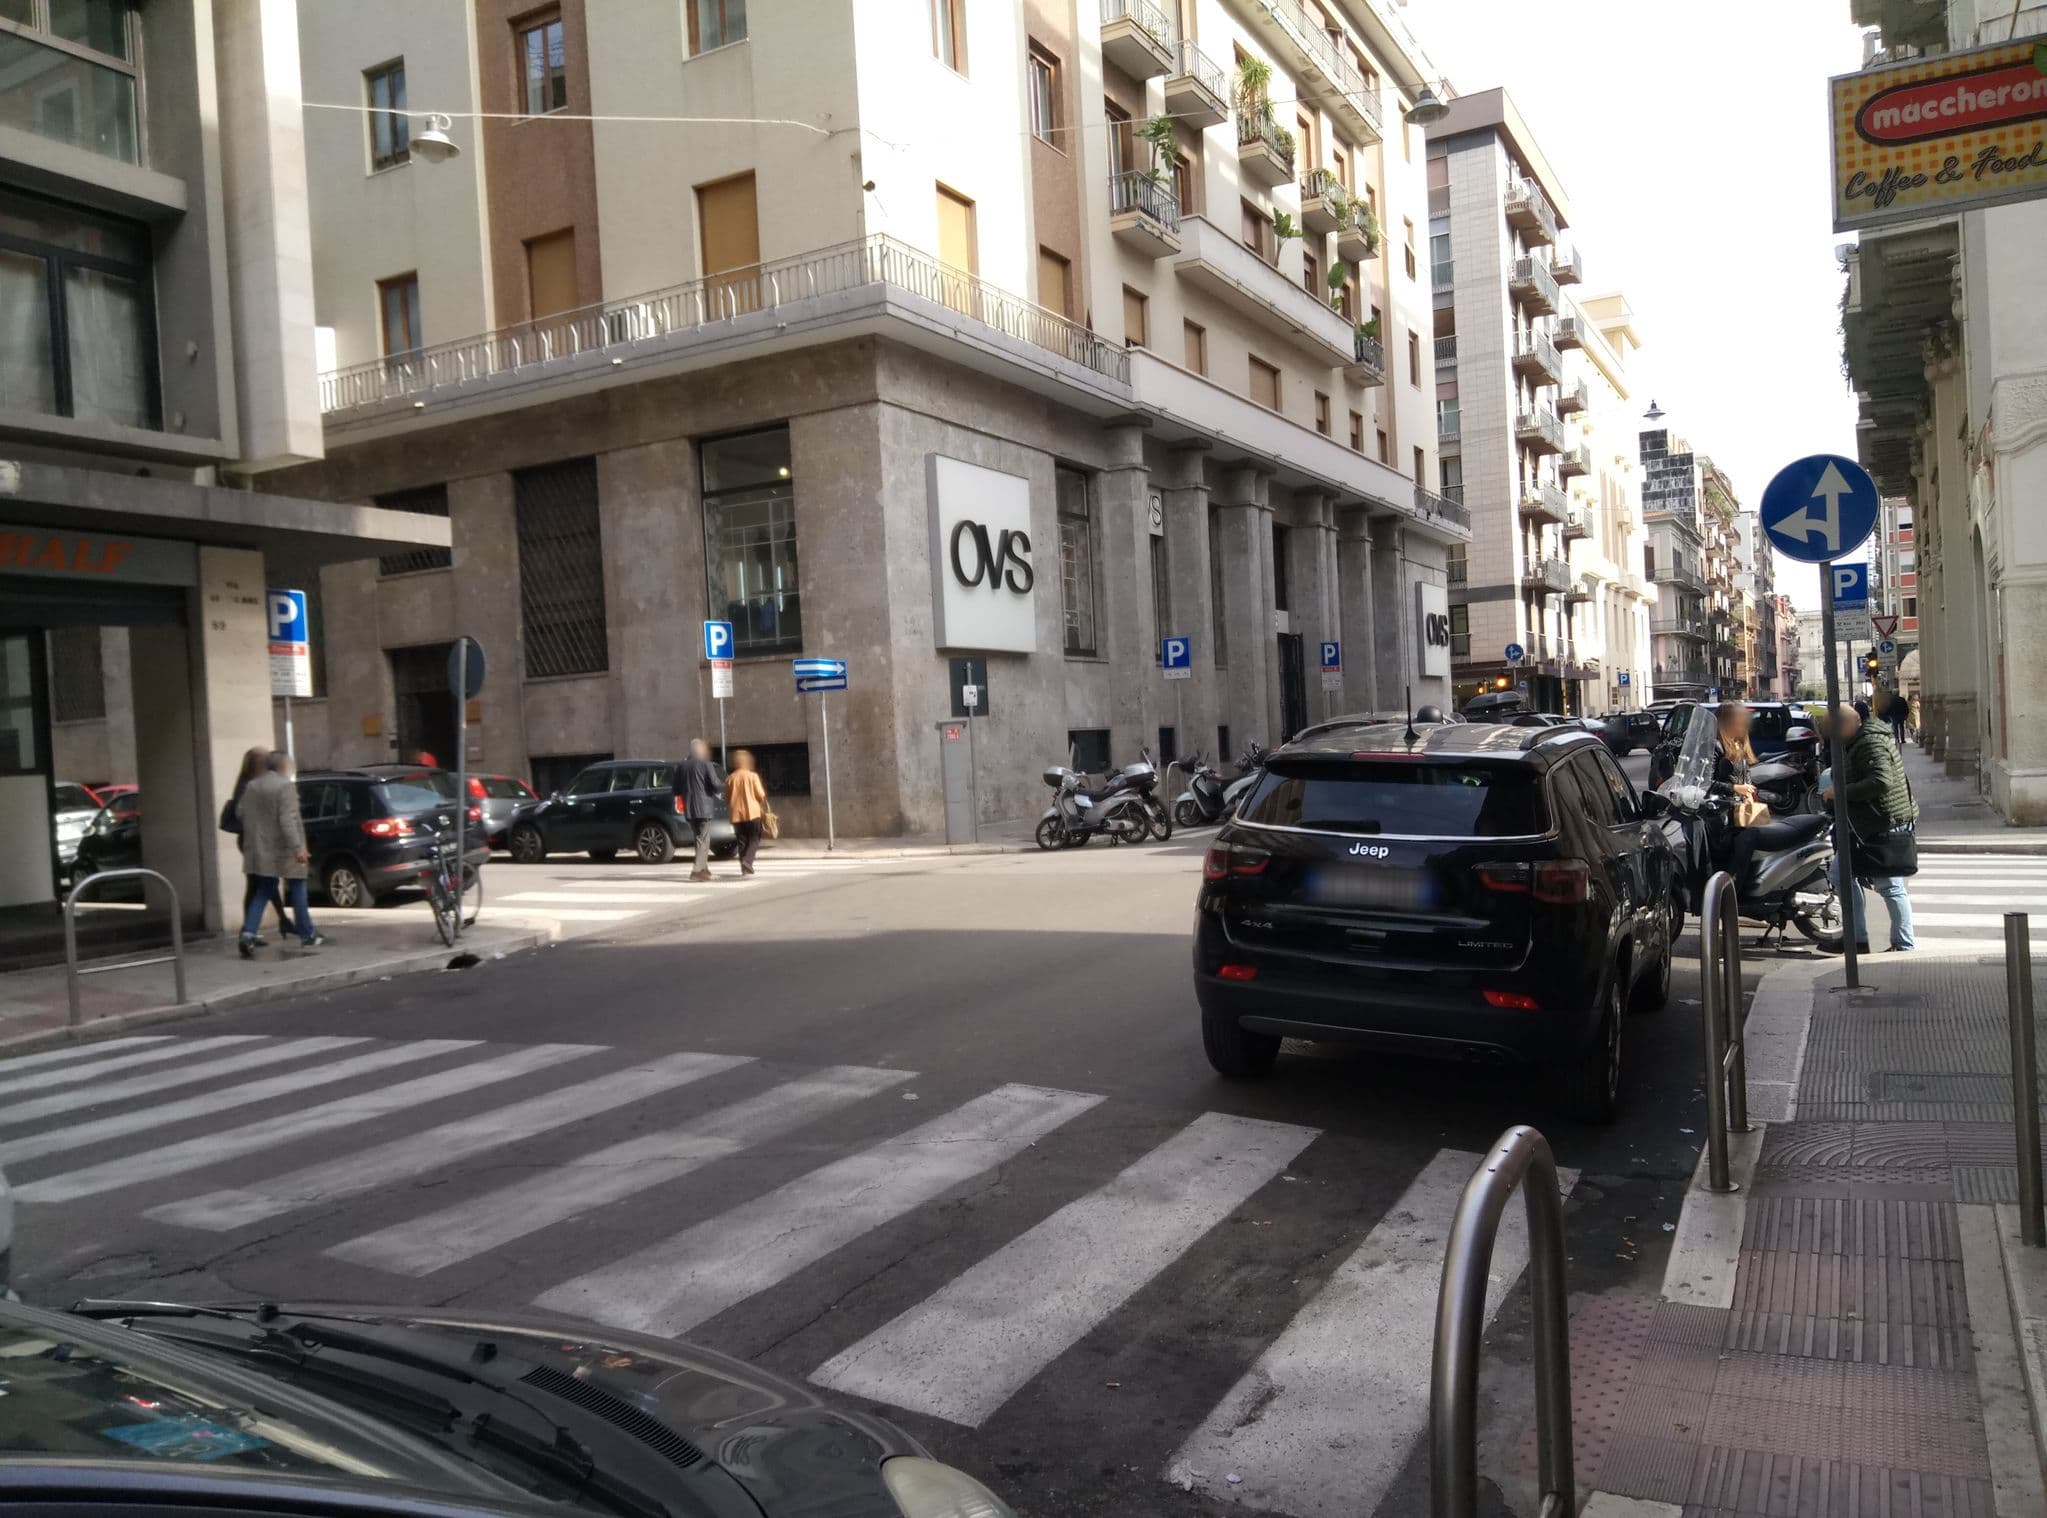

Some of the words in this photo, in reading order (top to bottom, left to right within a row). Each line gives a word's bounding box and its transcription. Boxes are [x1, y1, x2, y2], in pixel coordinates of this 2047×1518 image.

[1845, 166, 1928, 209] Coffee
[1935, 156, 1964, 185] &
[1971, 141, 2047, 183] Food
[950, 520, 1034, 594] OVS
[1833, 568, 1858, 598] P
[268, 595, 299, 637] P
[1426, 612, 1449, 647] OVS
[709, 625, 728, 656] P
[1167, 640, 1185, 666] P
[1323, 644, 1336, 665] P
[1620, 673, 1629, 684] P
[1349, 842, 1389, 859] Jeep
[1457, 940, 1514, 949] LIMITED
